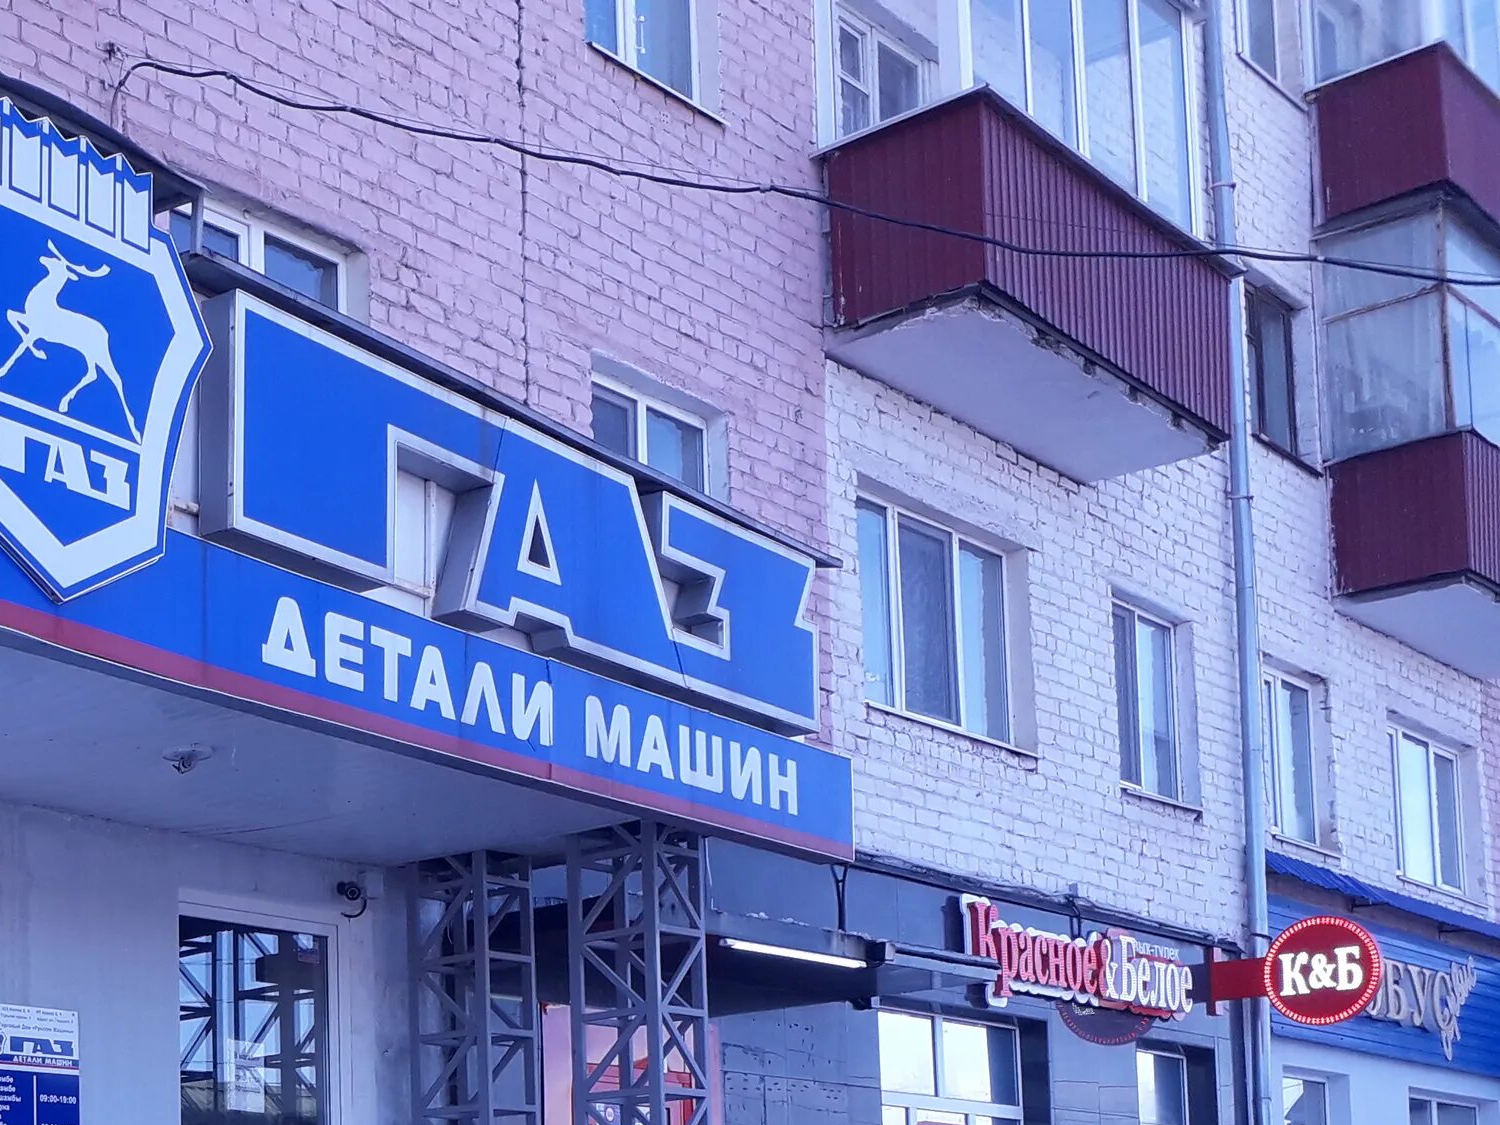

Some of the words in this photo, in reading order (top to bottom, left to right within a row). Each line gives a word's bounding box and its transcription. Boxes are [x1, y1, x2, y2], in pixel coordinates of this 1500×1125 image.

[228, 288, 822, 734] ГАЗ
[261, 596, 554, 747] ДЕТАЛИ
[584, 693, 800, 816] МАШИН
[1278, 945, 1363, 997] К&Б
[10, 1036, 74, 1057] ГАЗ
[13, 1055, 43, 1065] ДЕТАЛИ
[44, 1057, 73, 1067] МАШИН
